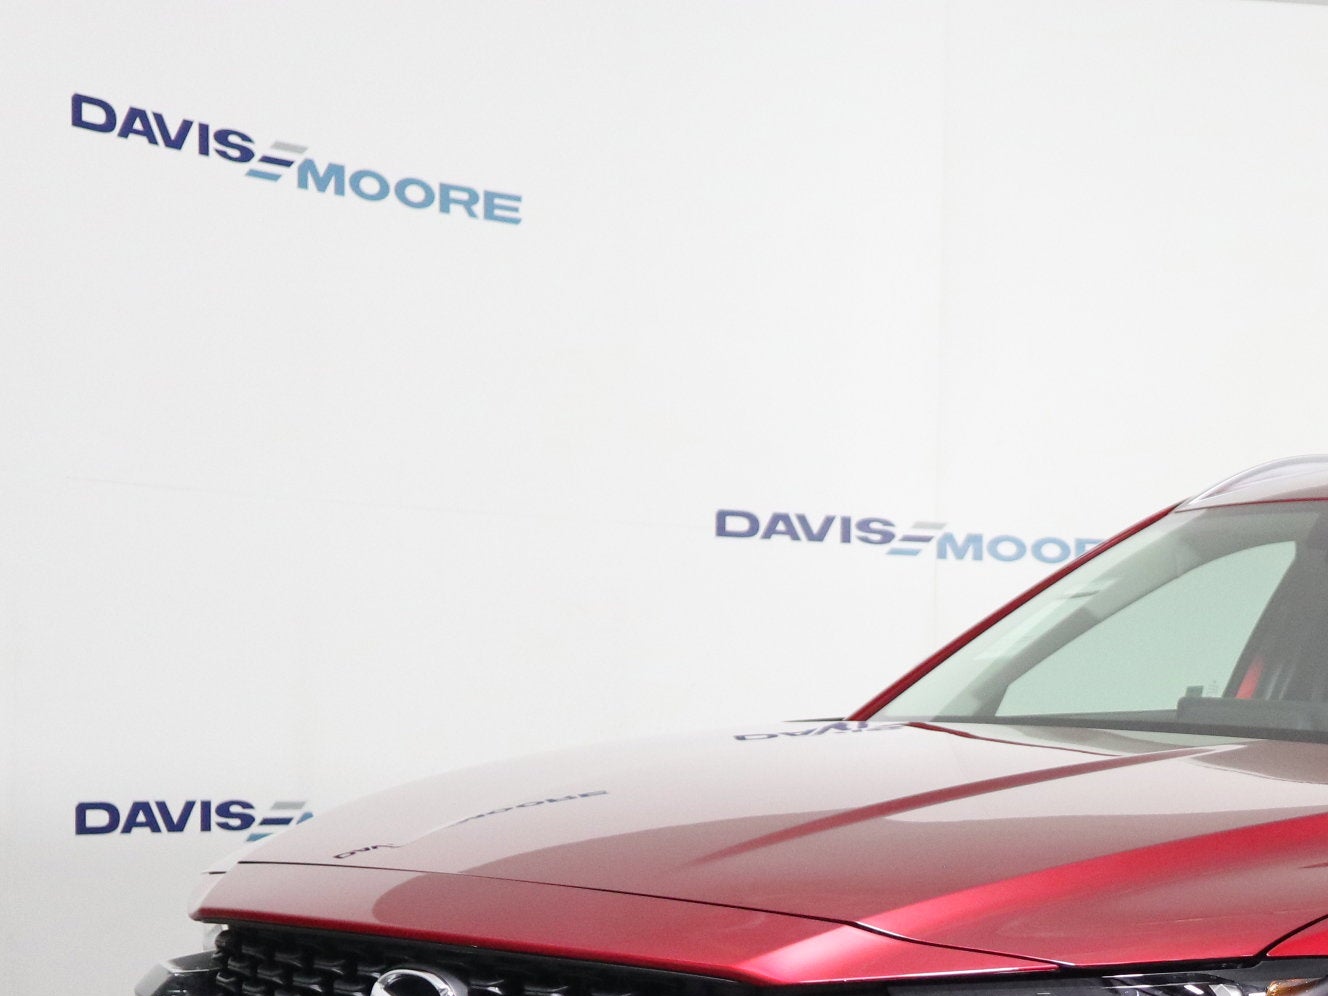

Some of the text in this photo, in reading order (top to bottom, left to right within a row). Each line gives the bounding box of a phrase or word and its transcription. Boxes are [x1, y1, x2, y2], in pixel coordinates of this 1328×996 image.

[71, 93, 523, 226] DAVIS MOORE
[715, 509, 1103, 564] DAVIS MOO
[75, 800, 256, 835] DAVIS
